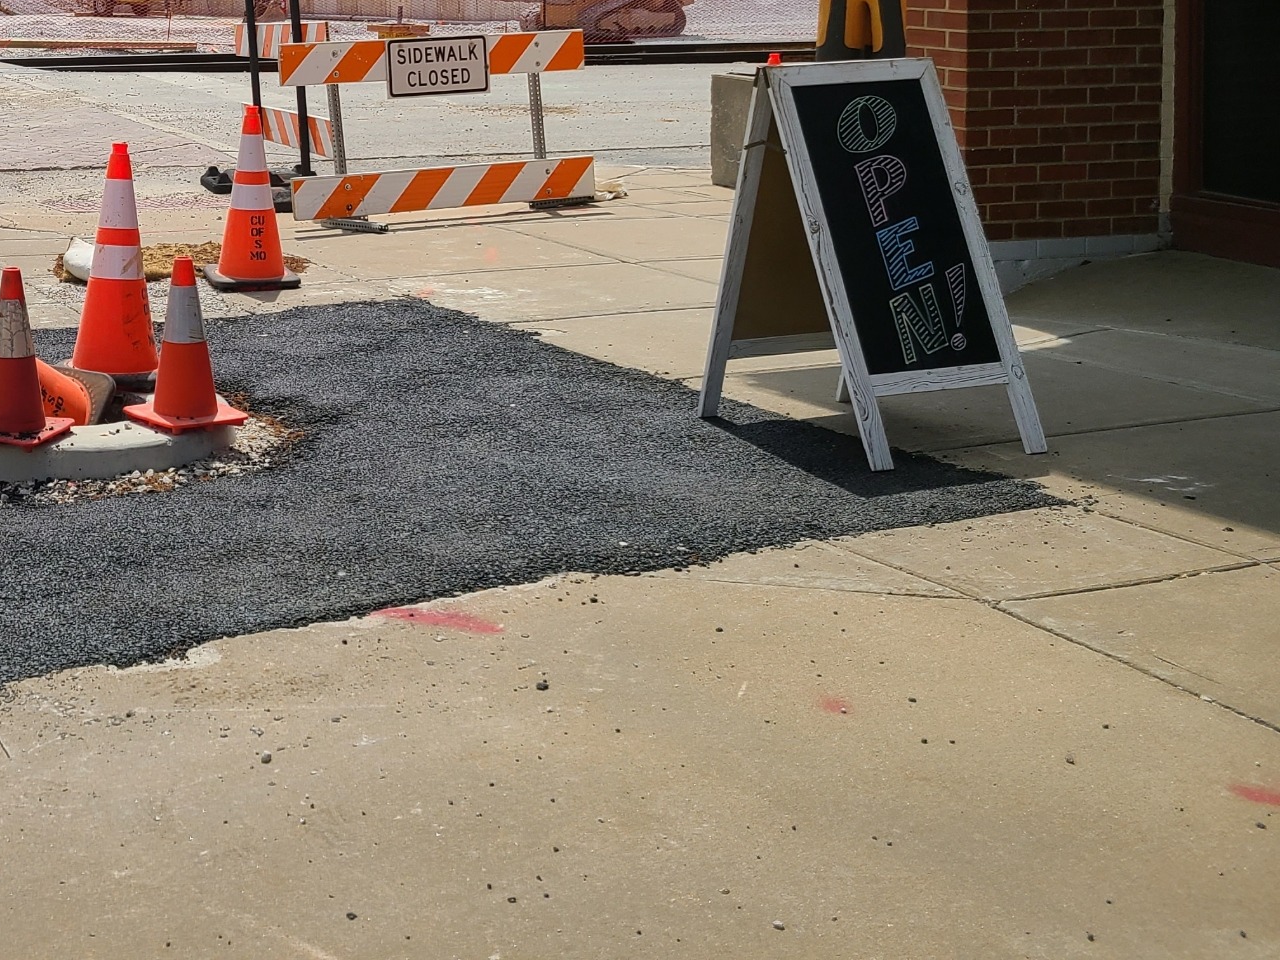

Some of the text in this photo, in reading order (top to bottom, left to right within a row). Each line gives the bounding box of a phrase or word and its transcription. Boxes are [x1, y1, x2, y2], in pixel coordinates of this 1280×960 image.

[397, 44, 478, 65] SIDEWALK
[407, 67, 471, 87] CLOSED
[250, 227, 265, 237] OF
[254, 239, 263, 249] S
[249, 251, 267, 261] MO
